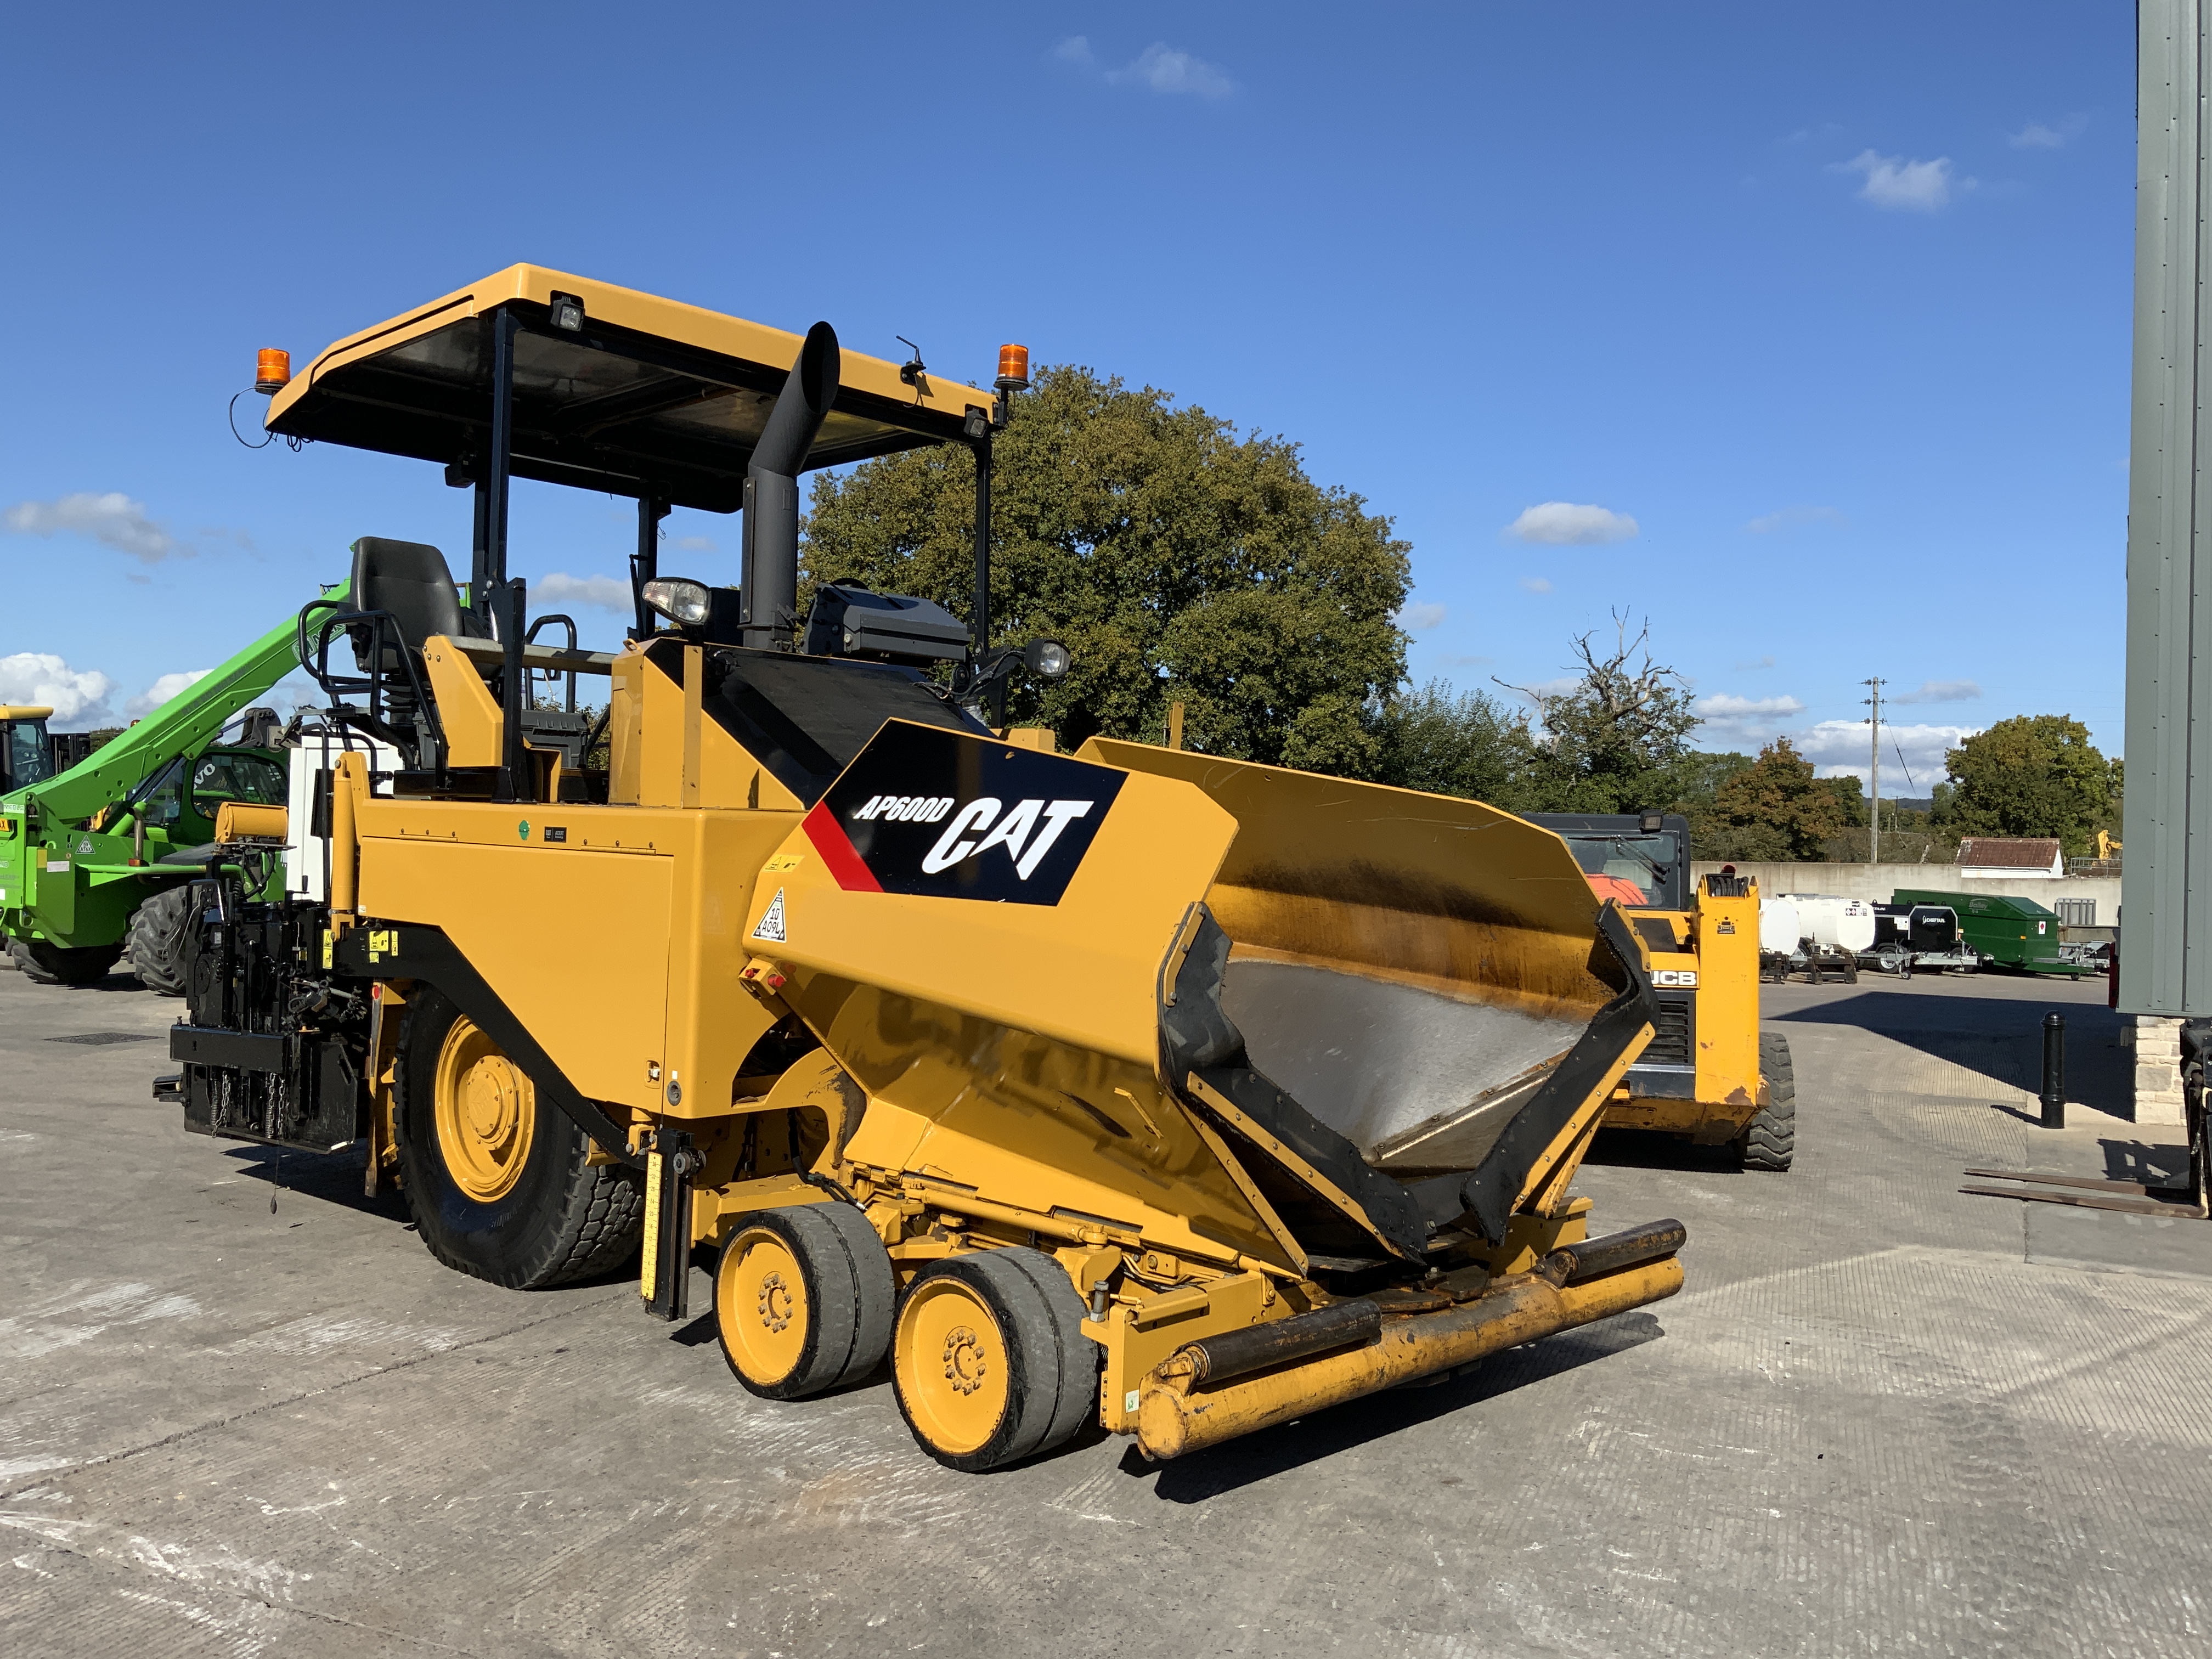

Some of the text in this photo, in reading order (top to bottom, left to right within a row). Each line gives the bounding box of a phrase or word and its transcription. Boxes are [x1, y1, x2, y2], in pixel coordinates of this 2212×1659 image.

[853, 795, 955, 823] AP600D
[922, 797, 1095, 881] CAT
[770, 908, 780, 921] 10
[761, 920, 781, 934] A09L
[1651, 970, 1696, 985] JCB
